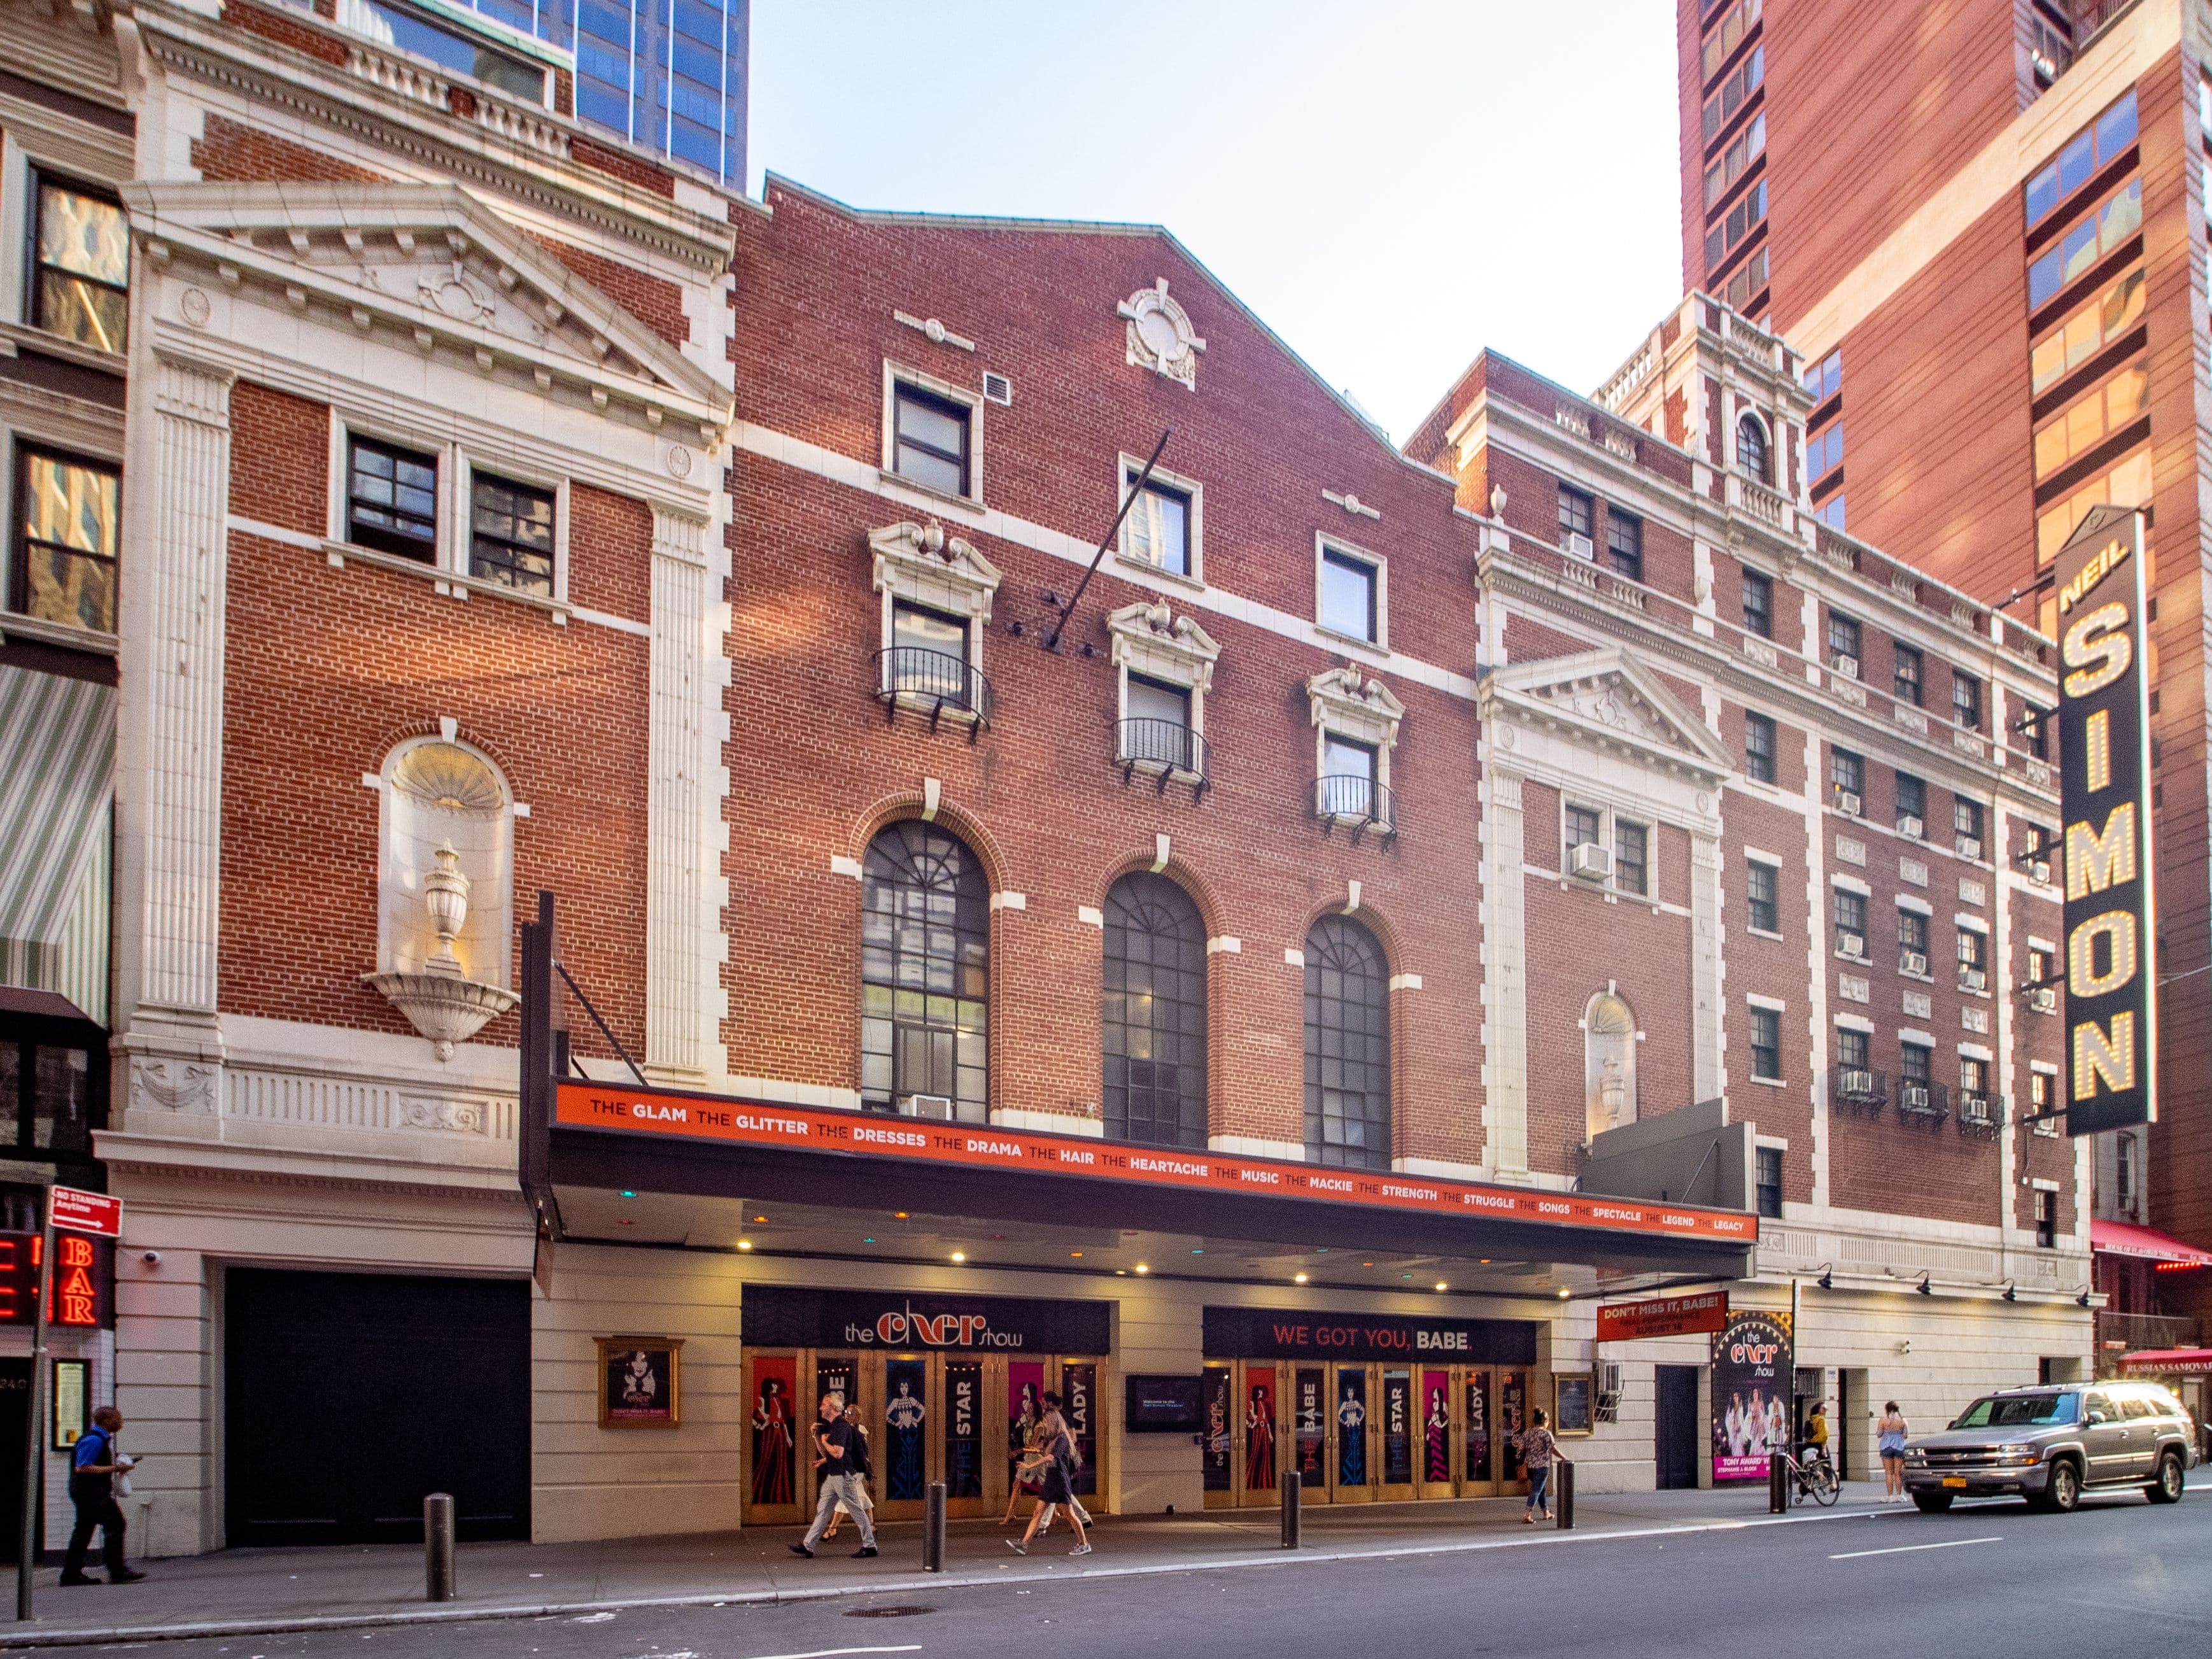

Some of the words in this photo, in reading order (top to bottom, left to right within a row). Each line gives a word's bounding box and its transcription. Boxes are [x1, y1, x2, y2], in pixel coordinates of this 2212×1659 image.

[2060, 539, 2130, 612] NEIL
[2063, 602, 2136, 1101] SIMON
[590, 1099, 626, 1115] THE
[696, 1110, 730, 1126] THE
[817, 1124, 848, 1138] THE
[934, 1136, 962, 1150] THE
[1029, 1146, 1056, 1161] THE
[1101, 1154, 1127, 1167] THE
[1215, 1167, 1237, 1180] THE
[1285, 1174, 1307, 1187] THE
[1358, 1182, 1379, 1194] THE
[1443, 1191, 1461, 1203] THE
[1519, 1200, 1536, 1211] THE
[1574, 1206, 1591, 1216] THE
[1645, 1213, 1660, 1223] THE
[1698, 1218, 1712, 1228] THE
[56, 1191, 69, 1200] NO
[71, 1193, 111, 1208] STANDING
[57, 1200, 91, 1213] Anytime
[64, 1237, 97, 1324] BAR
[845, 1323, 873, 1342] the
[877, 1299, 986, 1345] cher
[979, 1327, 1022, 1346] show
[1604, 1307, 1637, 1320] DON'T
[1639, 1304, 1665, 1315] MISS
[1667, 1301, 1680, 1313] IT,
[1682, 1296, 1719, 1310] BABE!
[1273, 1325, 1309, 1345] WE
[1315, 1326, 1359, 1346] GOT
[1365, 1329, 1410, 1352] YOU,
[1730, 1335, 1778, 1364] cher
[1747, 1330, 1760, 1343] the
[1754, 1364, 1775, 1377] show
[956, 1381, 971, 1436] STAR
[1073, 1381, 1086, 1434] LADY
[1304, 1383, 1315, 1432] BABE
[1391, 1387, 1402, 1432] STAR
[1472, 1386, 1483, 1431] LADY
[1304, 1438, 1316, 1472] THE
[1722, 1458, 1740, 1466] TONY
